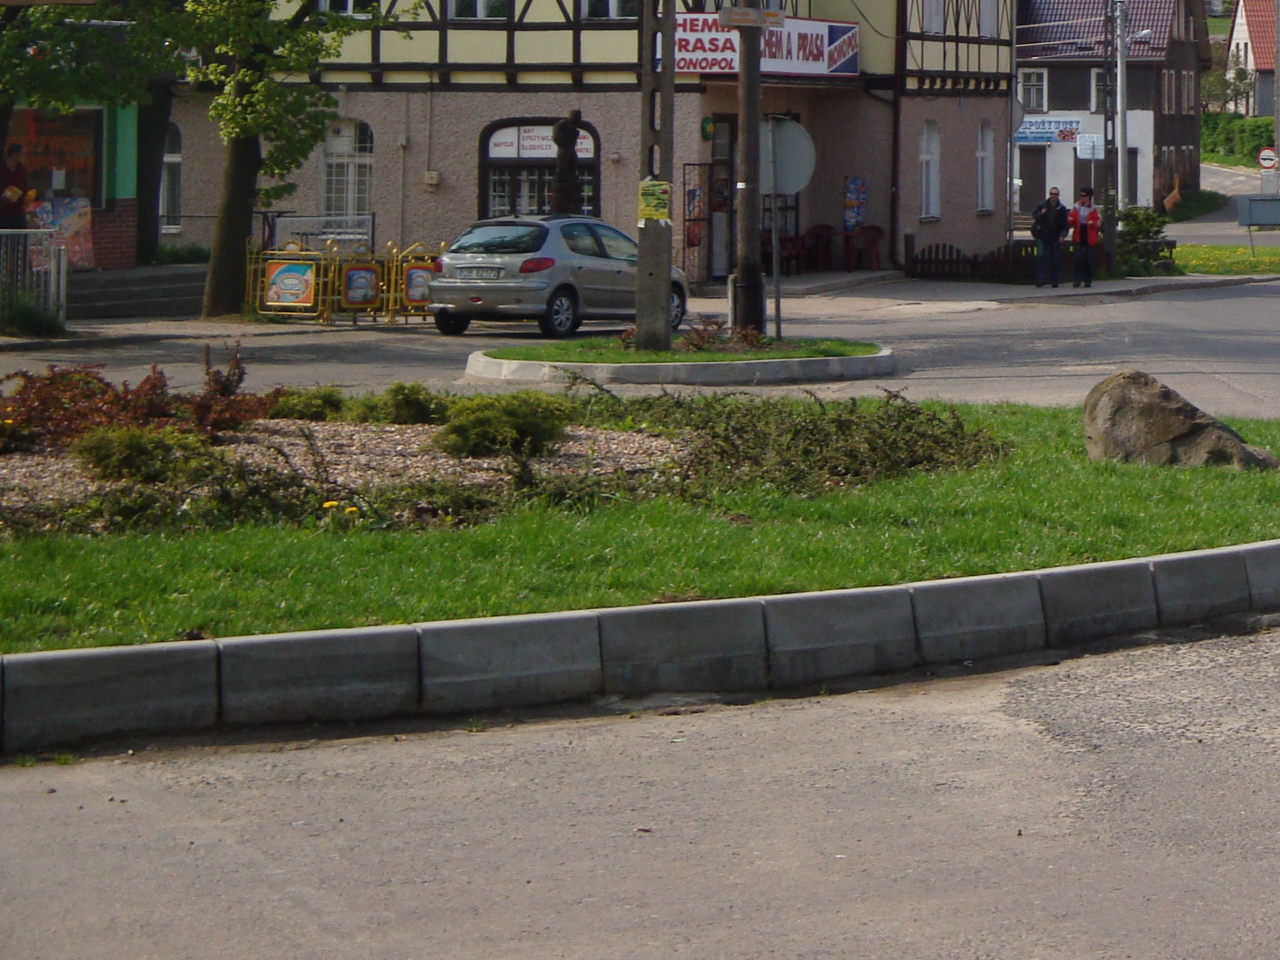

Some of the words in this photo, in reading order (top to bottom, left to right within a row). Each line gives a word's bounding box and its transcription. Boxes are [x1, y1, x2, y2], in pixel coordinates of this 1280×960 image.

[676, 37, 737, 53] RASA
[797, 32, 825, 62] PRASA
[676, 56, 735, 71] ONOPOL
